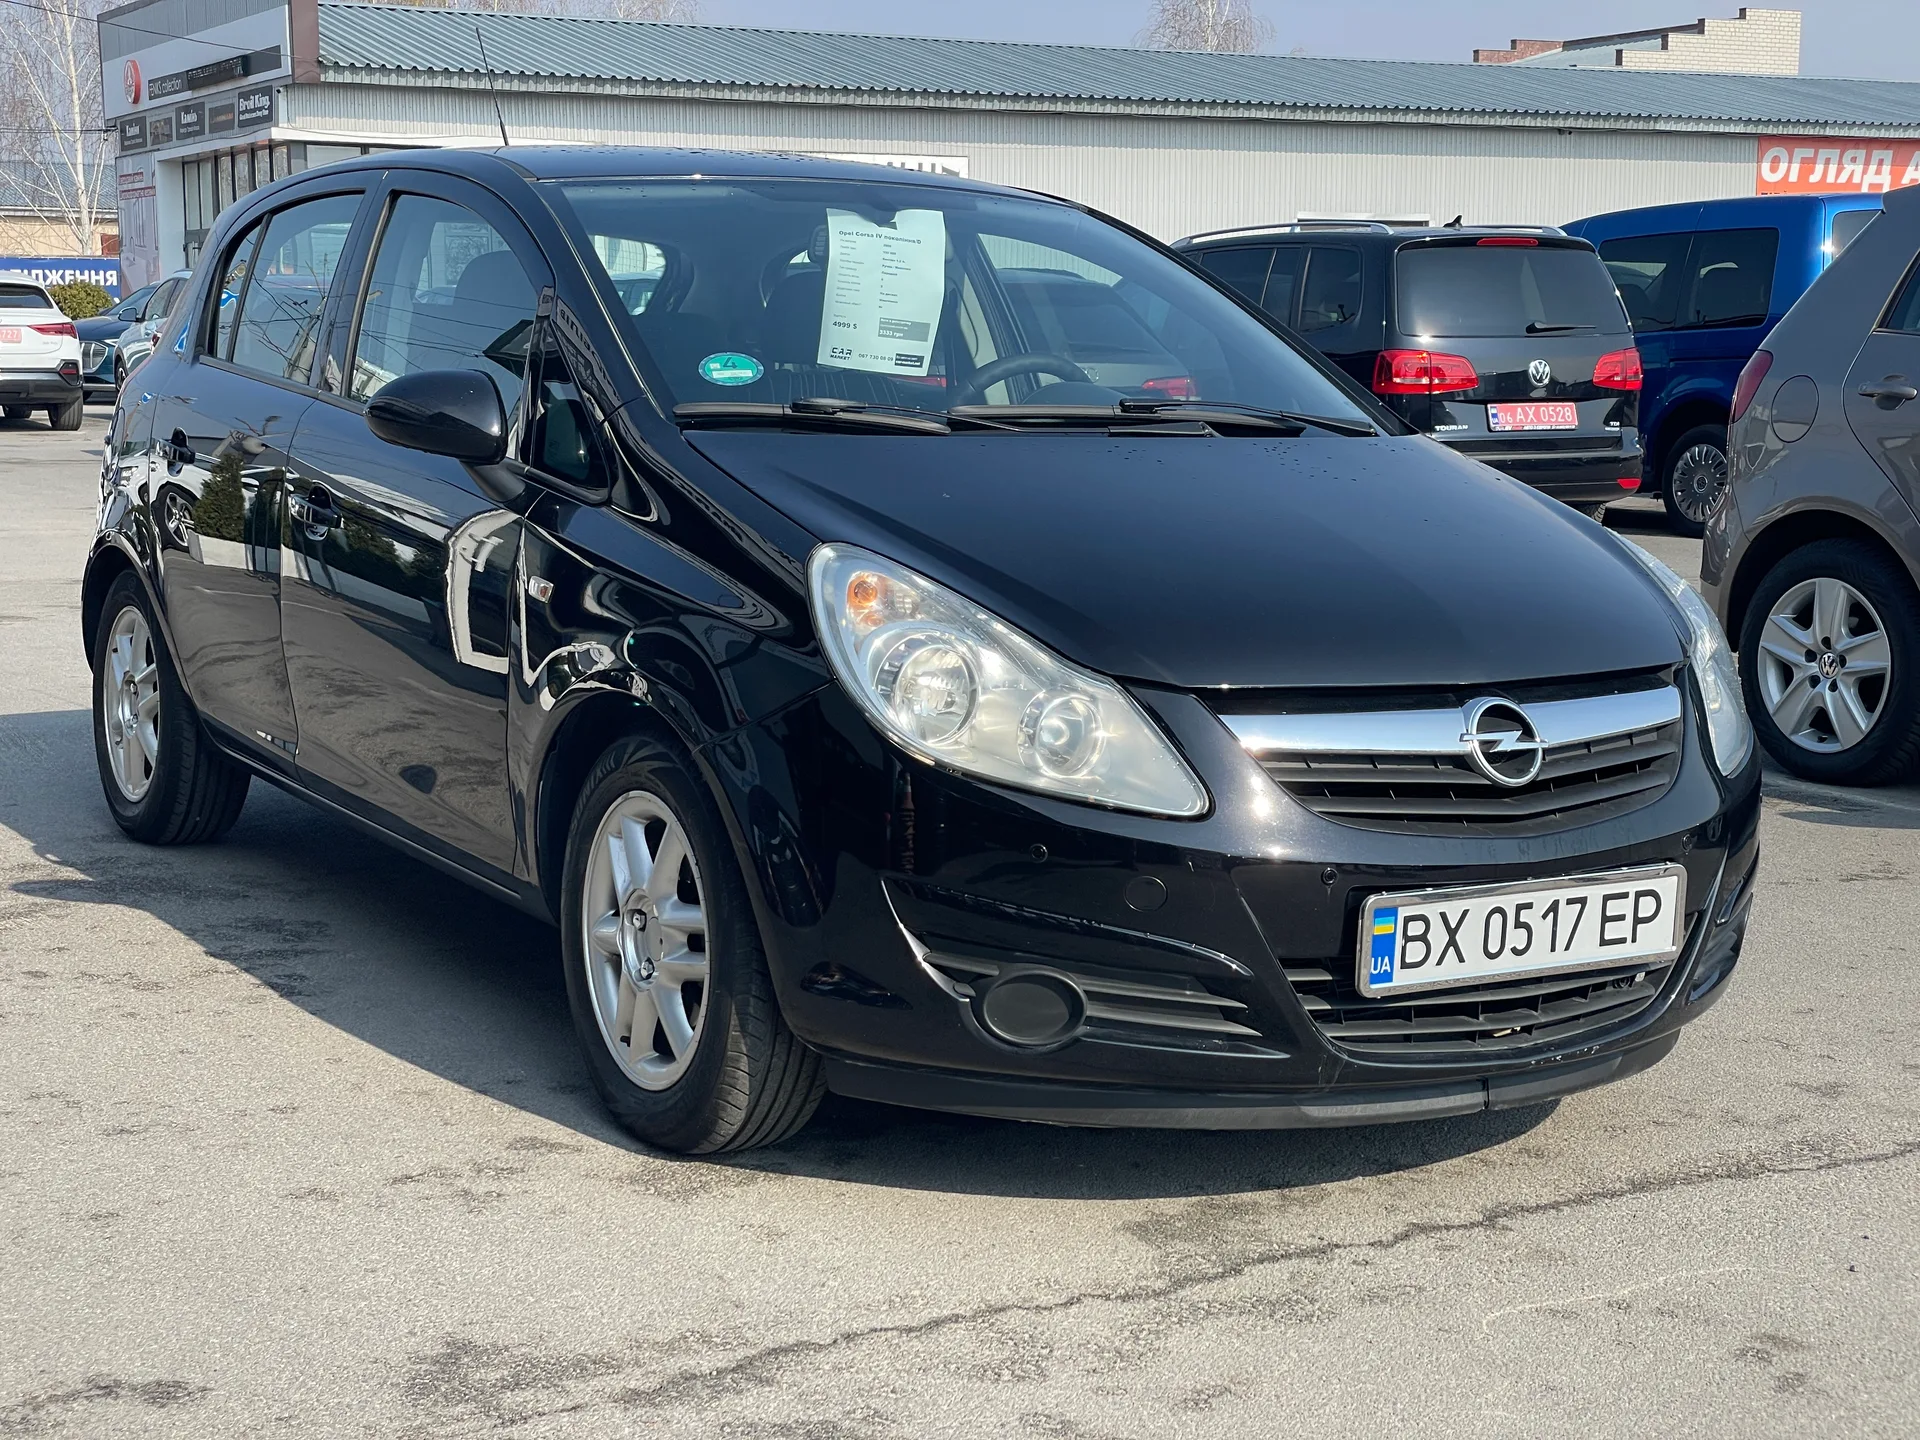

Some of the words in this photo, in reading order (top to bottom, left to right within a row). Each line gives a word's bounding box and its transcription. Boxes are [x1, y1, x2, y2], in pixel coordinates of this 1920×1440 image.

[1761, 146, 1894, 192] ОГЛЯД
[855, 231, 875, 239] Corsa
[832, 321, 851, 329] 4999
[1500, 412, 1513, 424] 06
[1516, 406, 1537, 423] AX
[1540, 407, 1573, 422] 0528
[1434, 424, 1469, 432] TOURAN
[1400, 908, 1470, 970] BX
[1482, 895, 1588, 961] 0517
[1599, 888, 1662, 947] EP
[1370, 957, 1391, 975] UA
